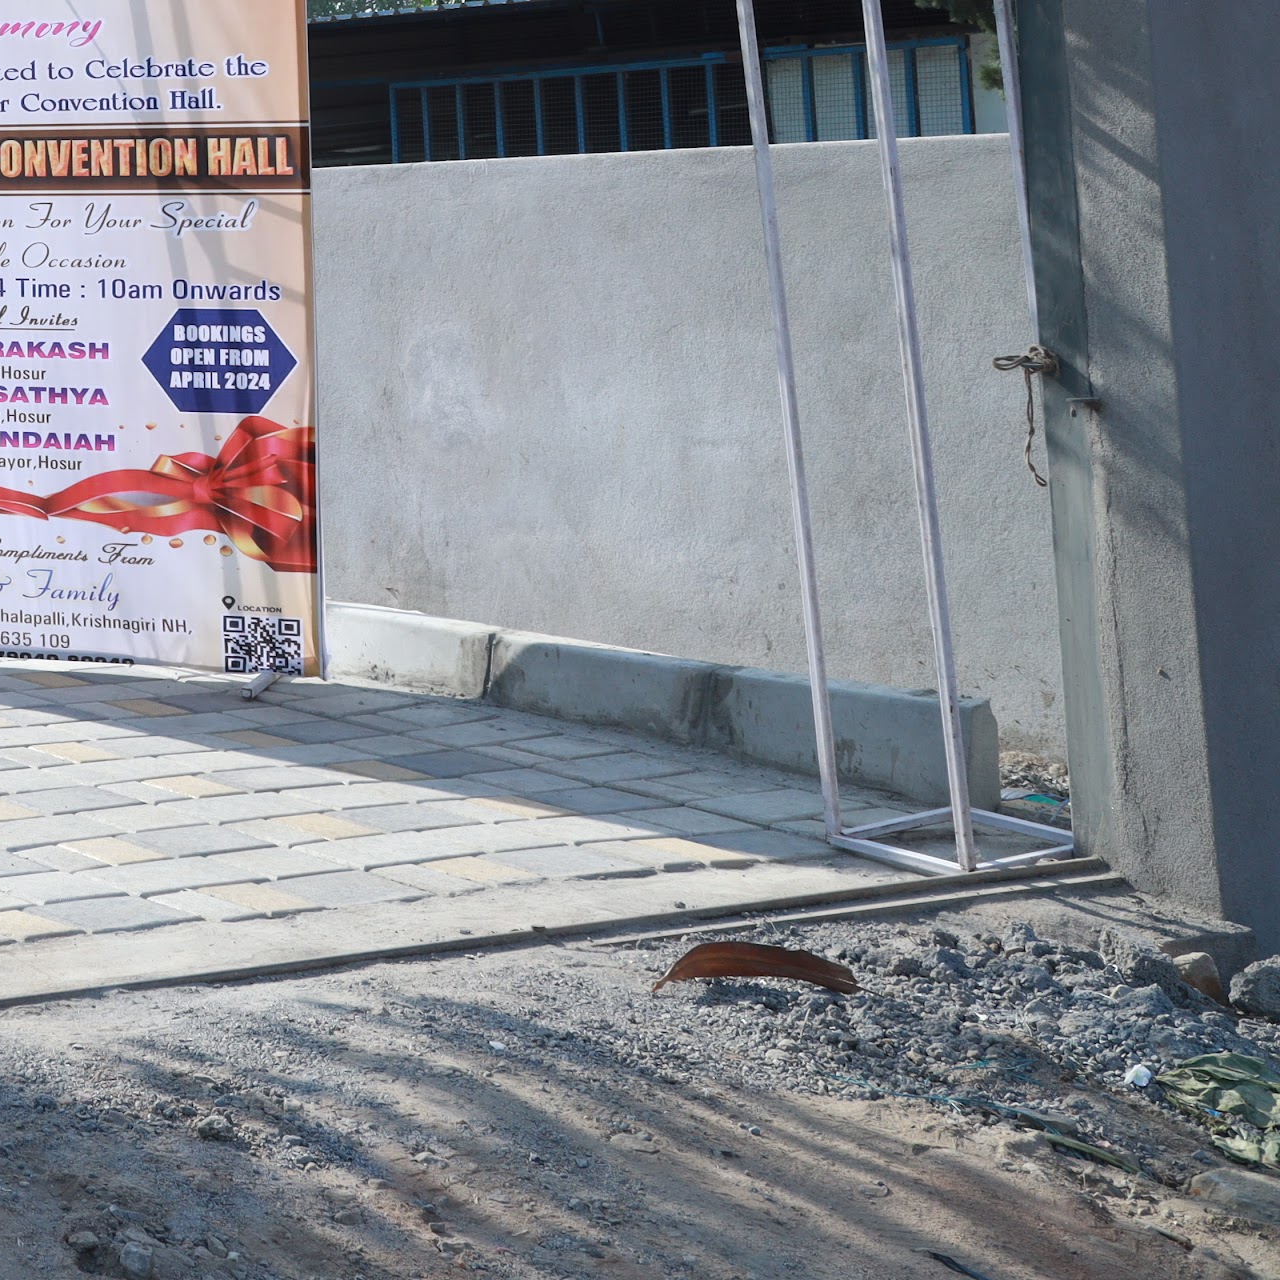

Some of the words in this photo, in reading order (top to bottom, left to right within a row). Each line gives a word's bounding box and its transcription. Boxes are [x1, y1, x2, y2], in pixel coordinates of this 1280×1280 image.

[47, 60, 74, 81] to
[84, 56, 215, 80] Celebrate
[225, 55, 267, 77] the
[20, 92, 158, 112] Convention
[169, 89, 222, 110] Hall.
[206, 136, 294, 177] HALL
[25, 202, 72, 229] For
[84, 202, 142, 235] Your
[149, 201, 256, 236] Special
[21, 241, 128, 269] Occasion
[16, 277, 71, 299] Time
[79, 282, 87, 299] :
[96, 278, 164, 300] 10am
[172, 279, 282, 302] Onwards
[9, 306, 79, 327] Invites
[173, 324, 267, 343] BOOKINGS
[170, 347, 216, 366] OPEN
[219, 348, 271, 367] FROM
[169, 371, 222, 390] APRIL
[224, 372, 272, 391] 2024
[97, 542, 156, 566] From
[22, 568, 121, 611] Family
[237, 605, 282, 613] LOCATION
[162, 618, 193, 635] NH,
[0, 630, 33, 646] 635
[39, 633, 71, 649] 109
